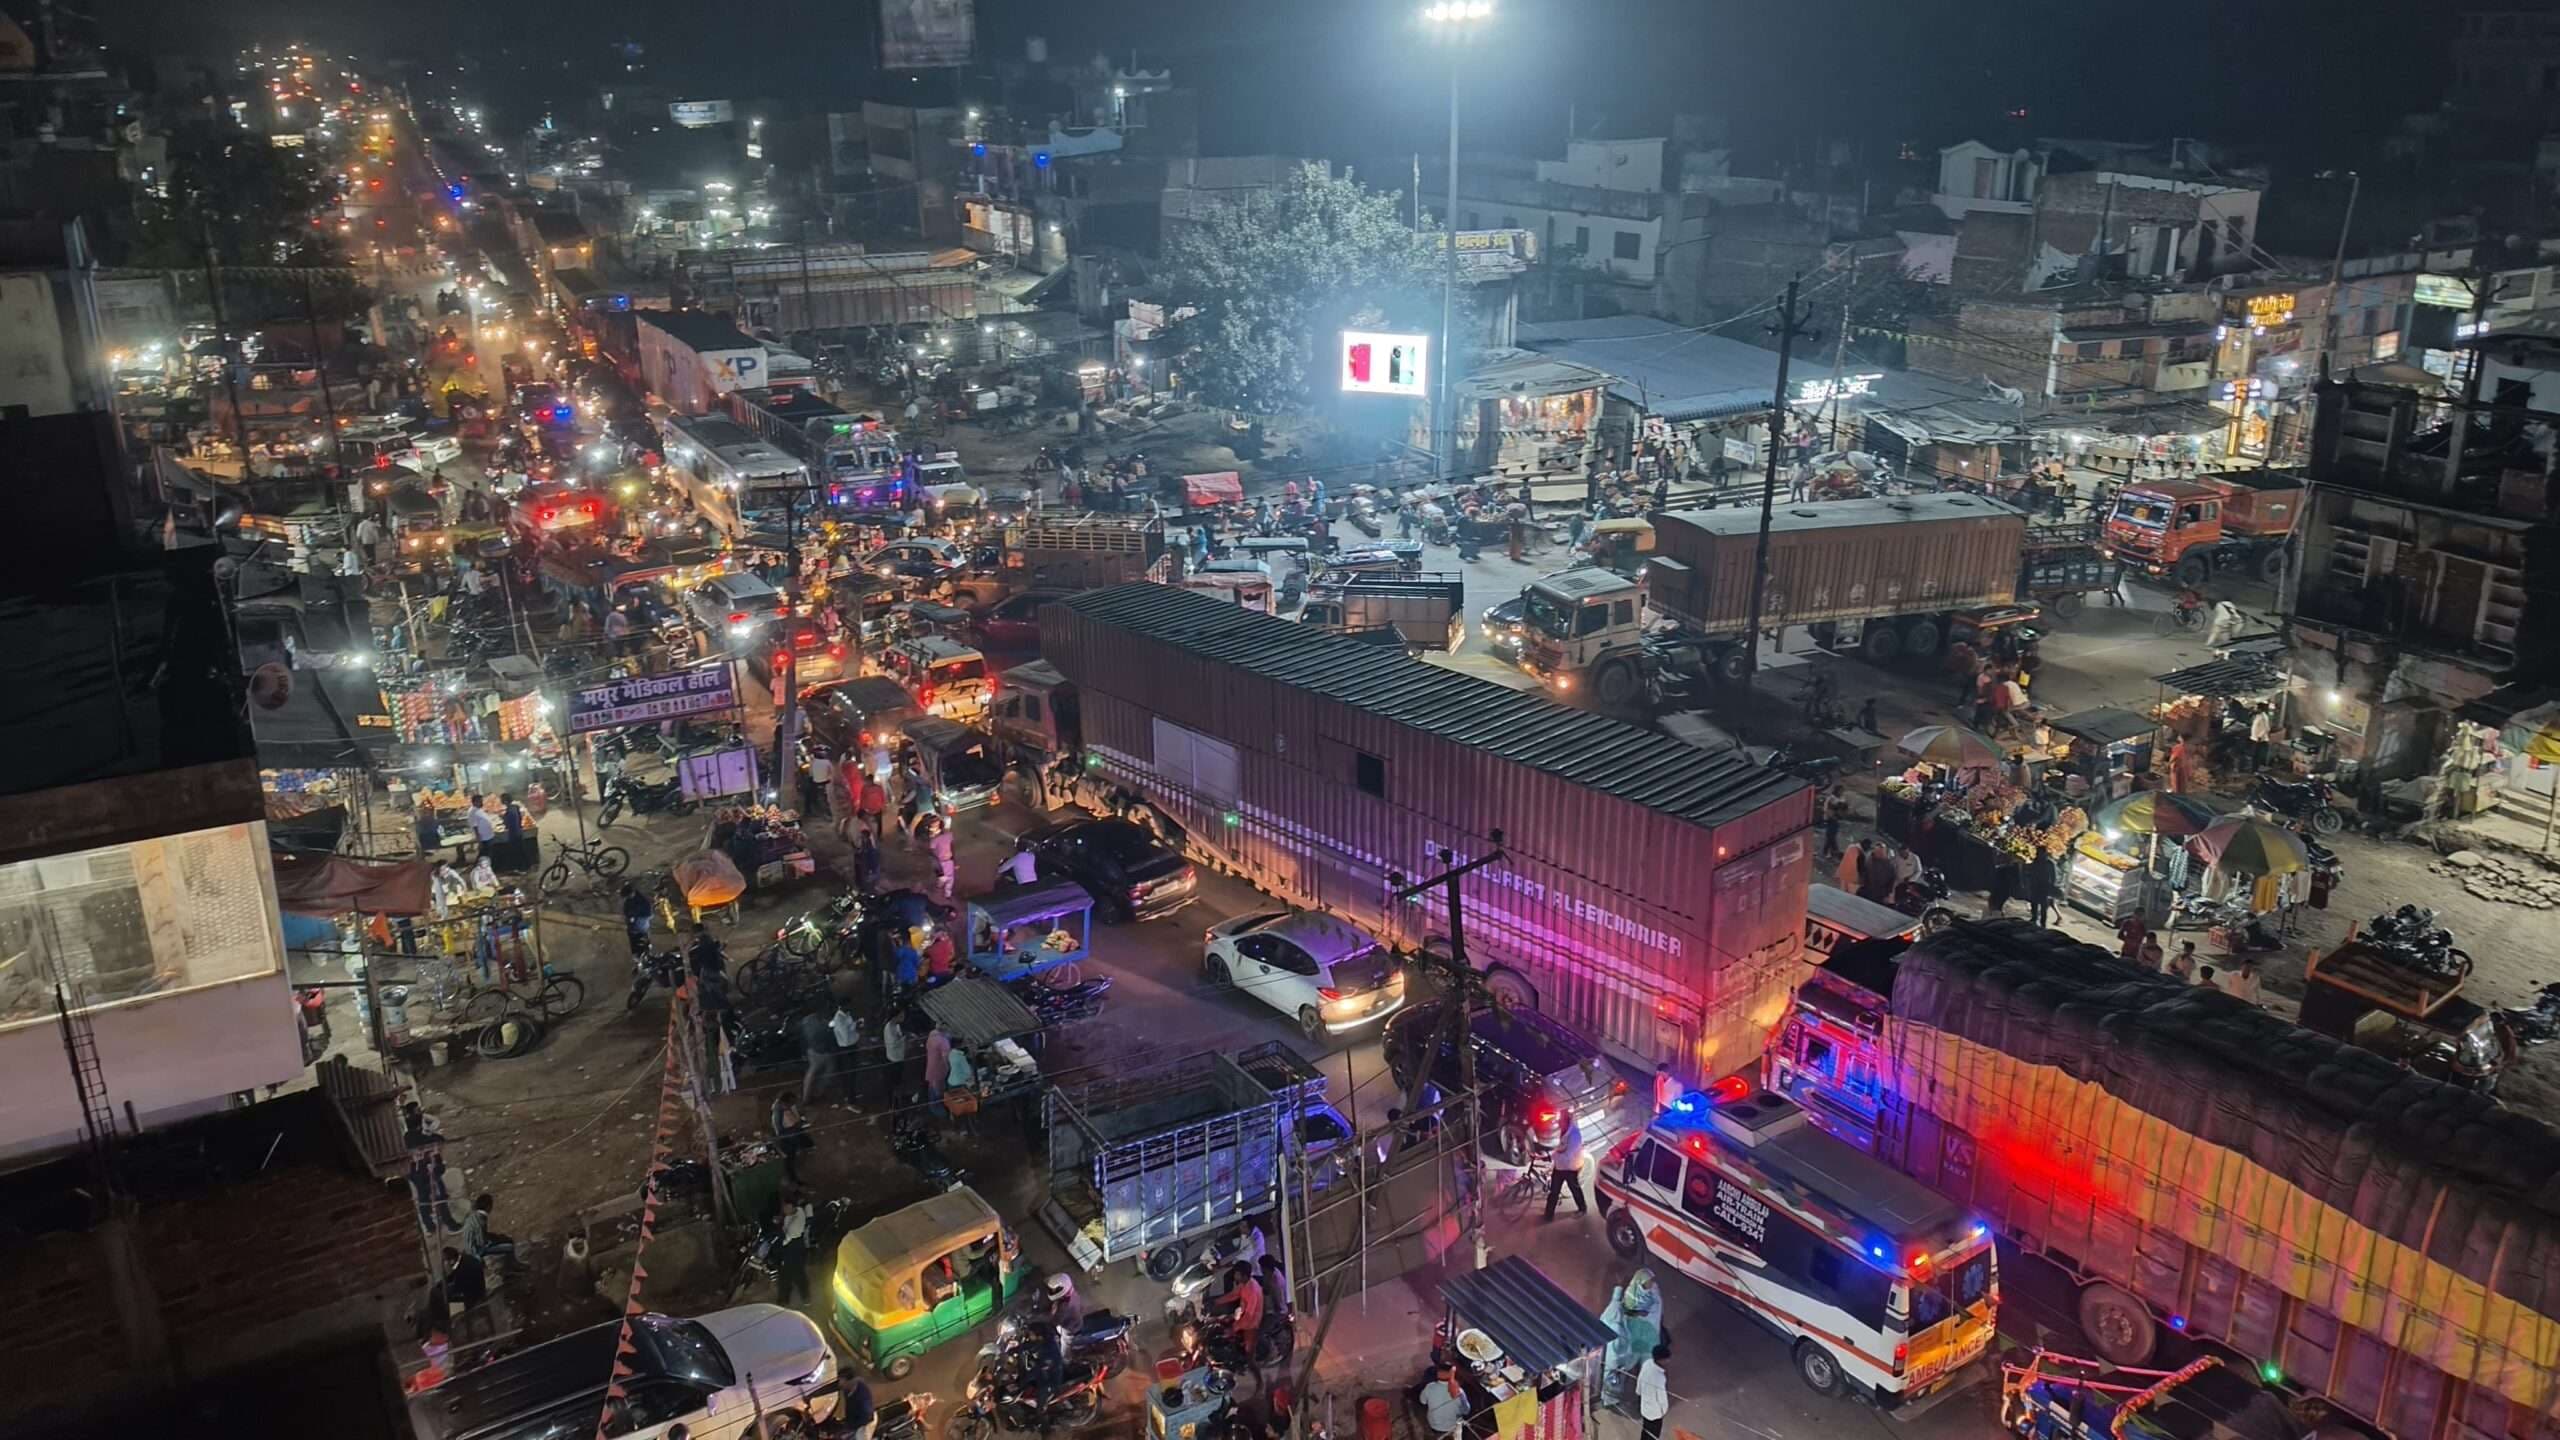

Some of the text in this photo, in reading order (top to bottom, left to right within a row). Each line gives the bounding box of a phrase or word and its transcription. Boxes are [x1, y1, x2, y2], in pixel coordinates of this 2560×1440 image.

[582, 668, 721, 708] मयूर मेडिकल हॉल
